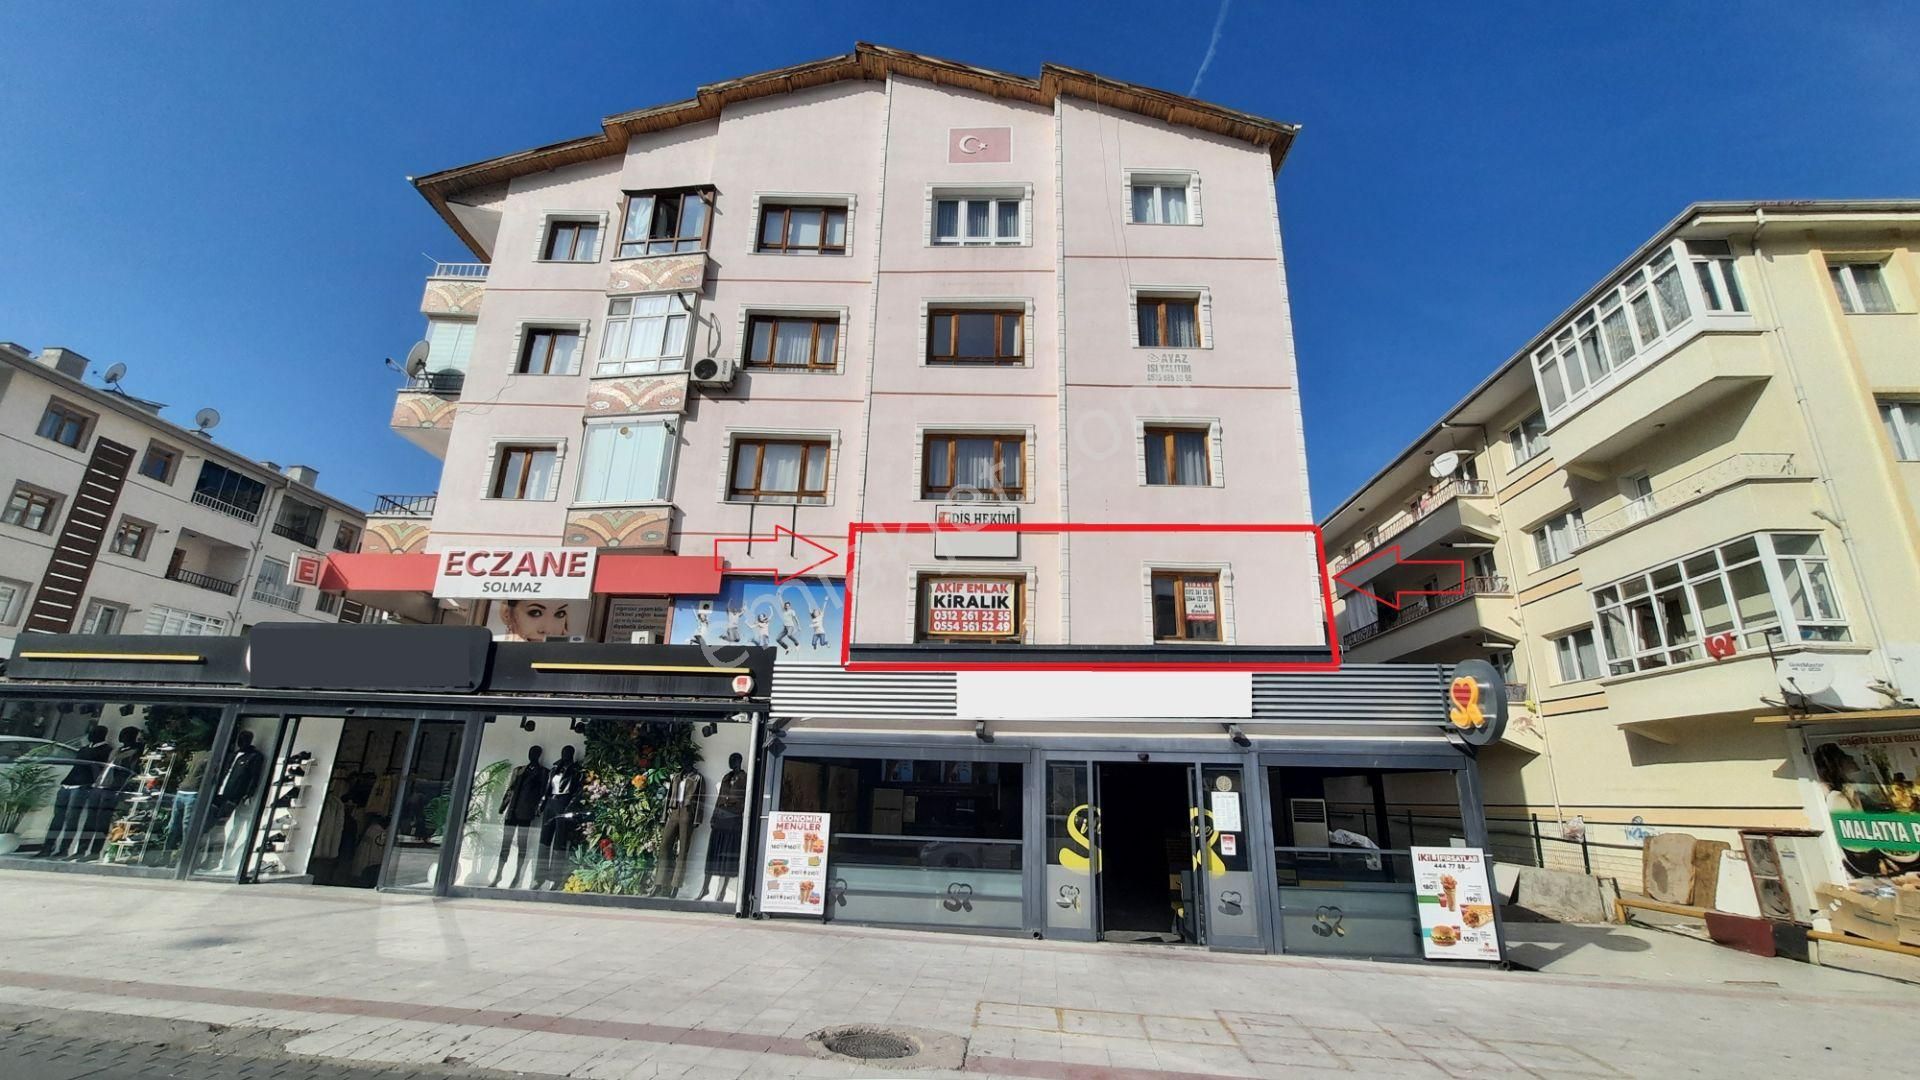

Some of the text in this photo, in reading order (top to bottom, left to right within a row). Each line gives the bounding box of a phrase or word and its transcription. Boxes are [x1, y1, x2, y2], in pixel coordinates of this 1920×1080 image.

[1161, 353, 1189, 364] AYAZ
[974, 510, 1016, 525] HEKİMİ
[444, 550, 589, 577] ECZANE
[299, 561, 315, 582] E
[482, 581, 543, 594] SOLMAZ
[935, 583, 1008, 594] AKİF EMLAK
[933, 611, 1011, 622] 0312 261 22 55
[933, 622, 1011, 632] 0554 561 52 49
[1838, 819, 1911, 843] MALATYA
